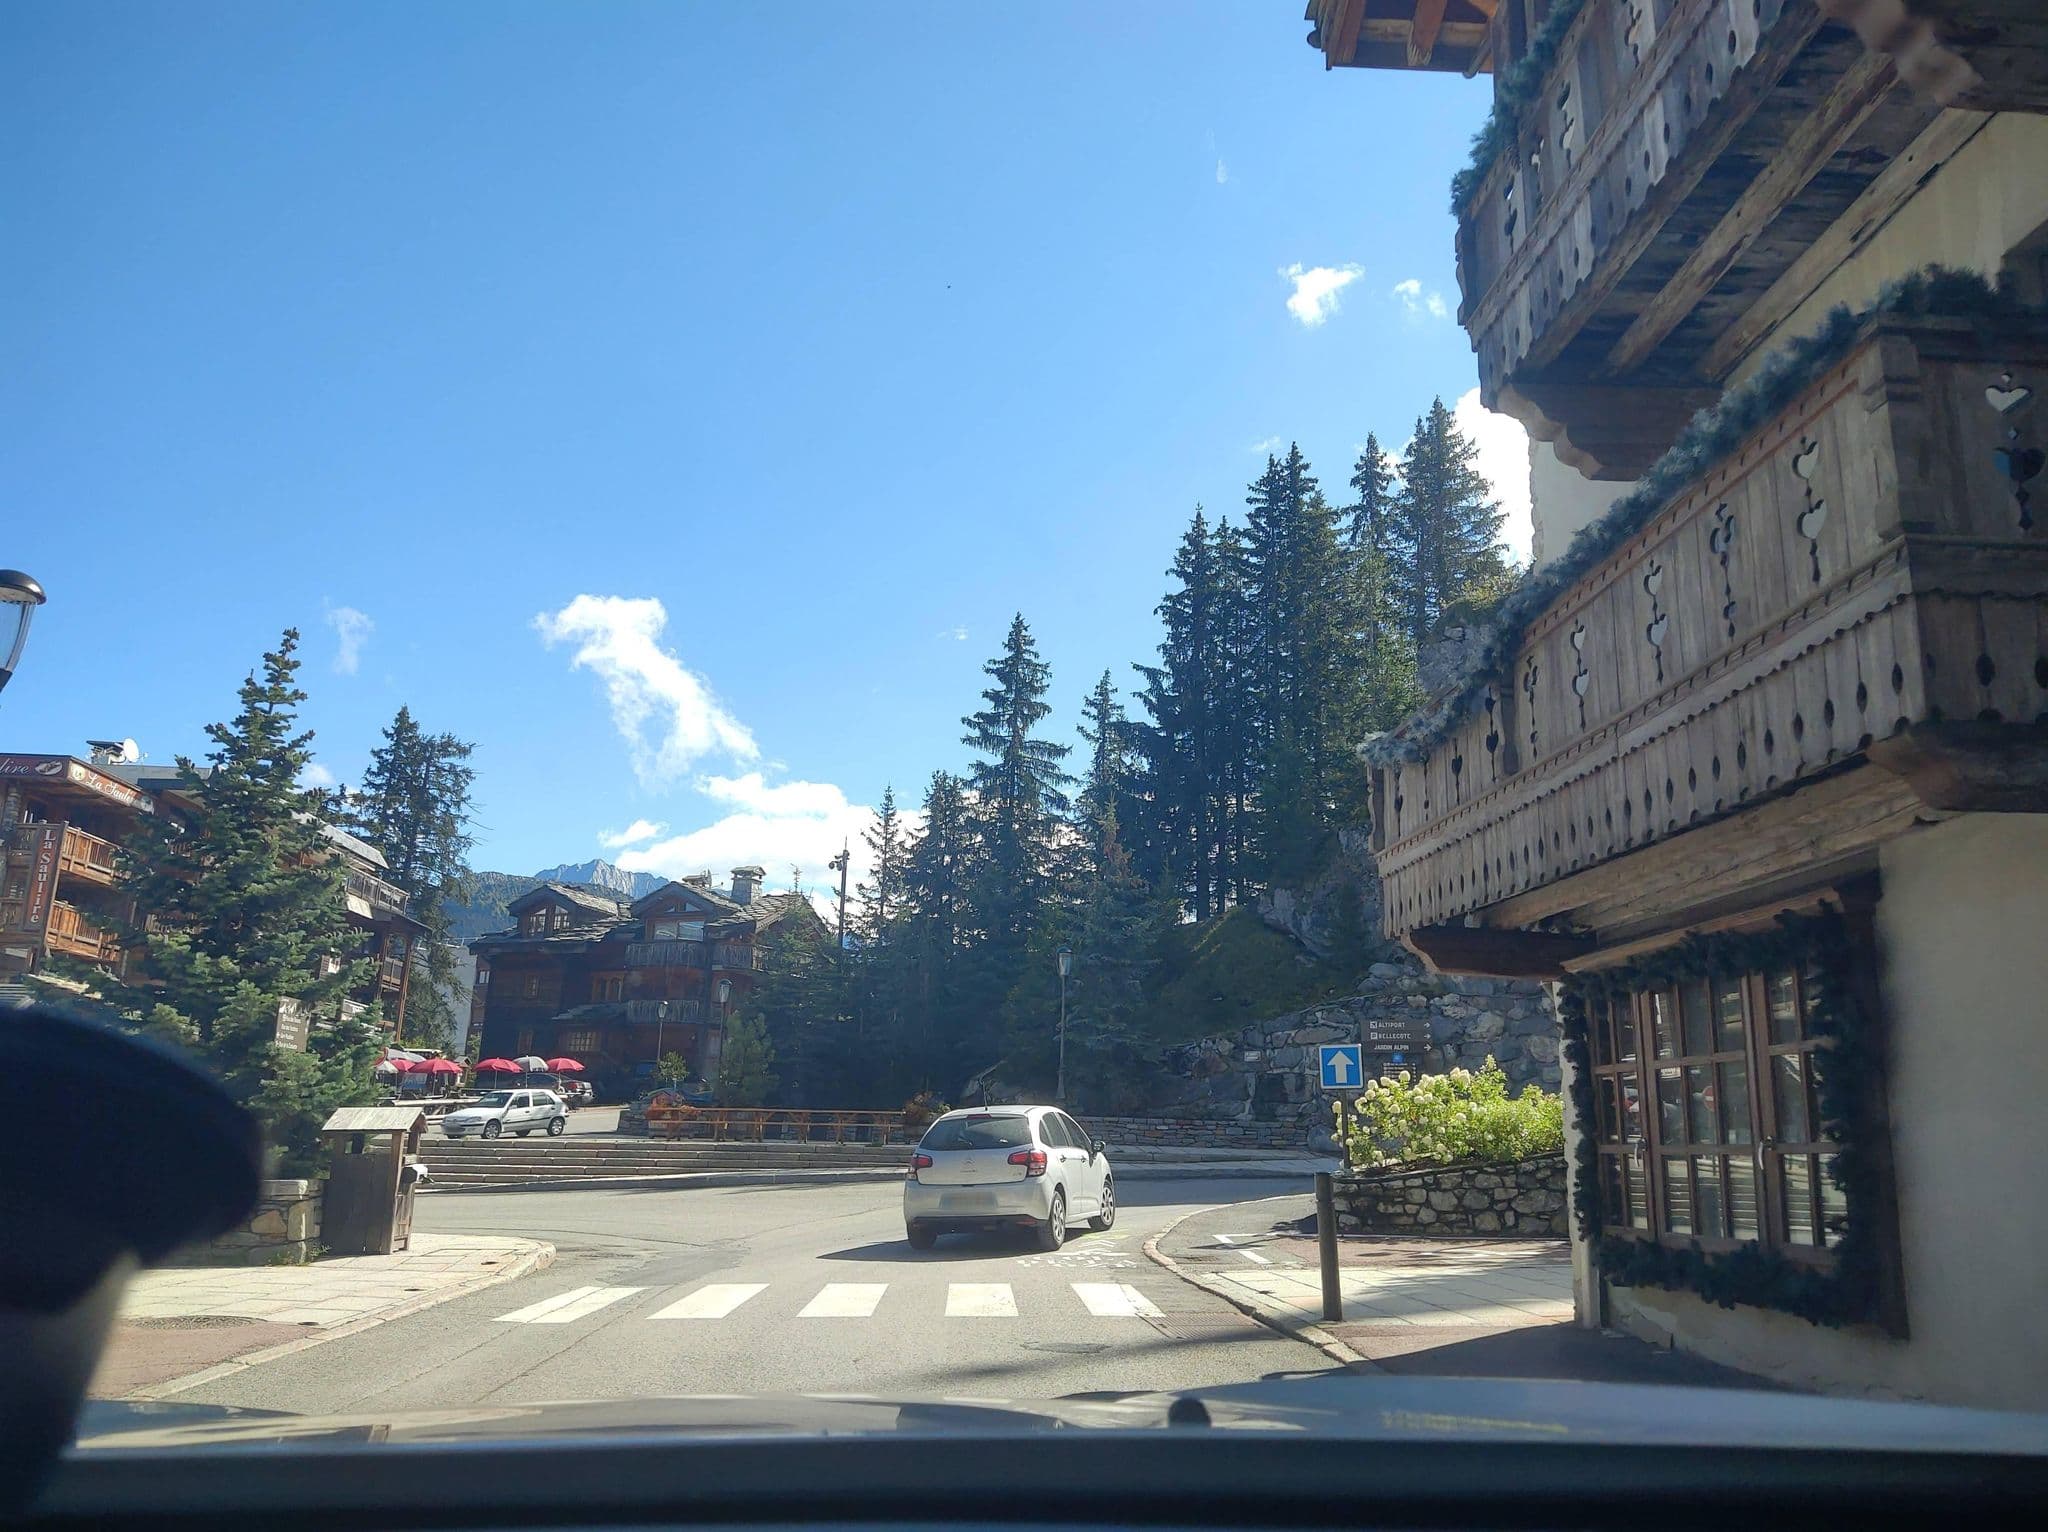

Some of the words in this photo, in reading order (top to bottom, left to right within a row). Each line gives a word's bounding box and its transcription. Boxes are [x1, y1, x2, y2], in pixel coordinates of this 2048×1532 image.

[85, 770, 103, 790] La
[43, 829, 56, 849] La
[30, 852, 51, 923] Saulire
